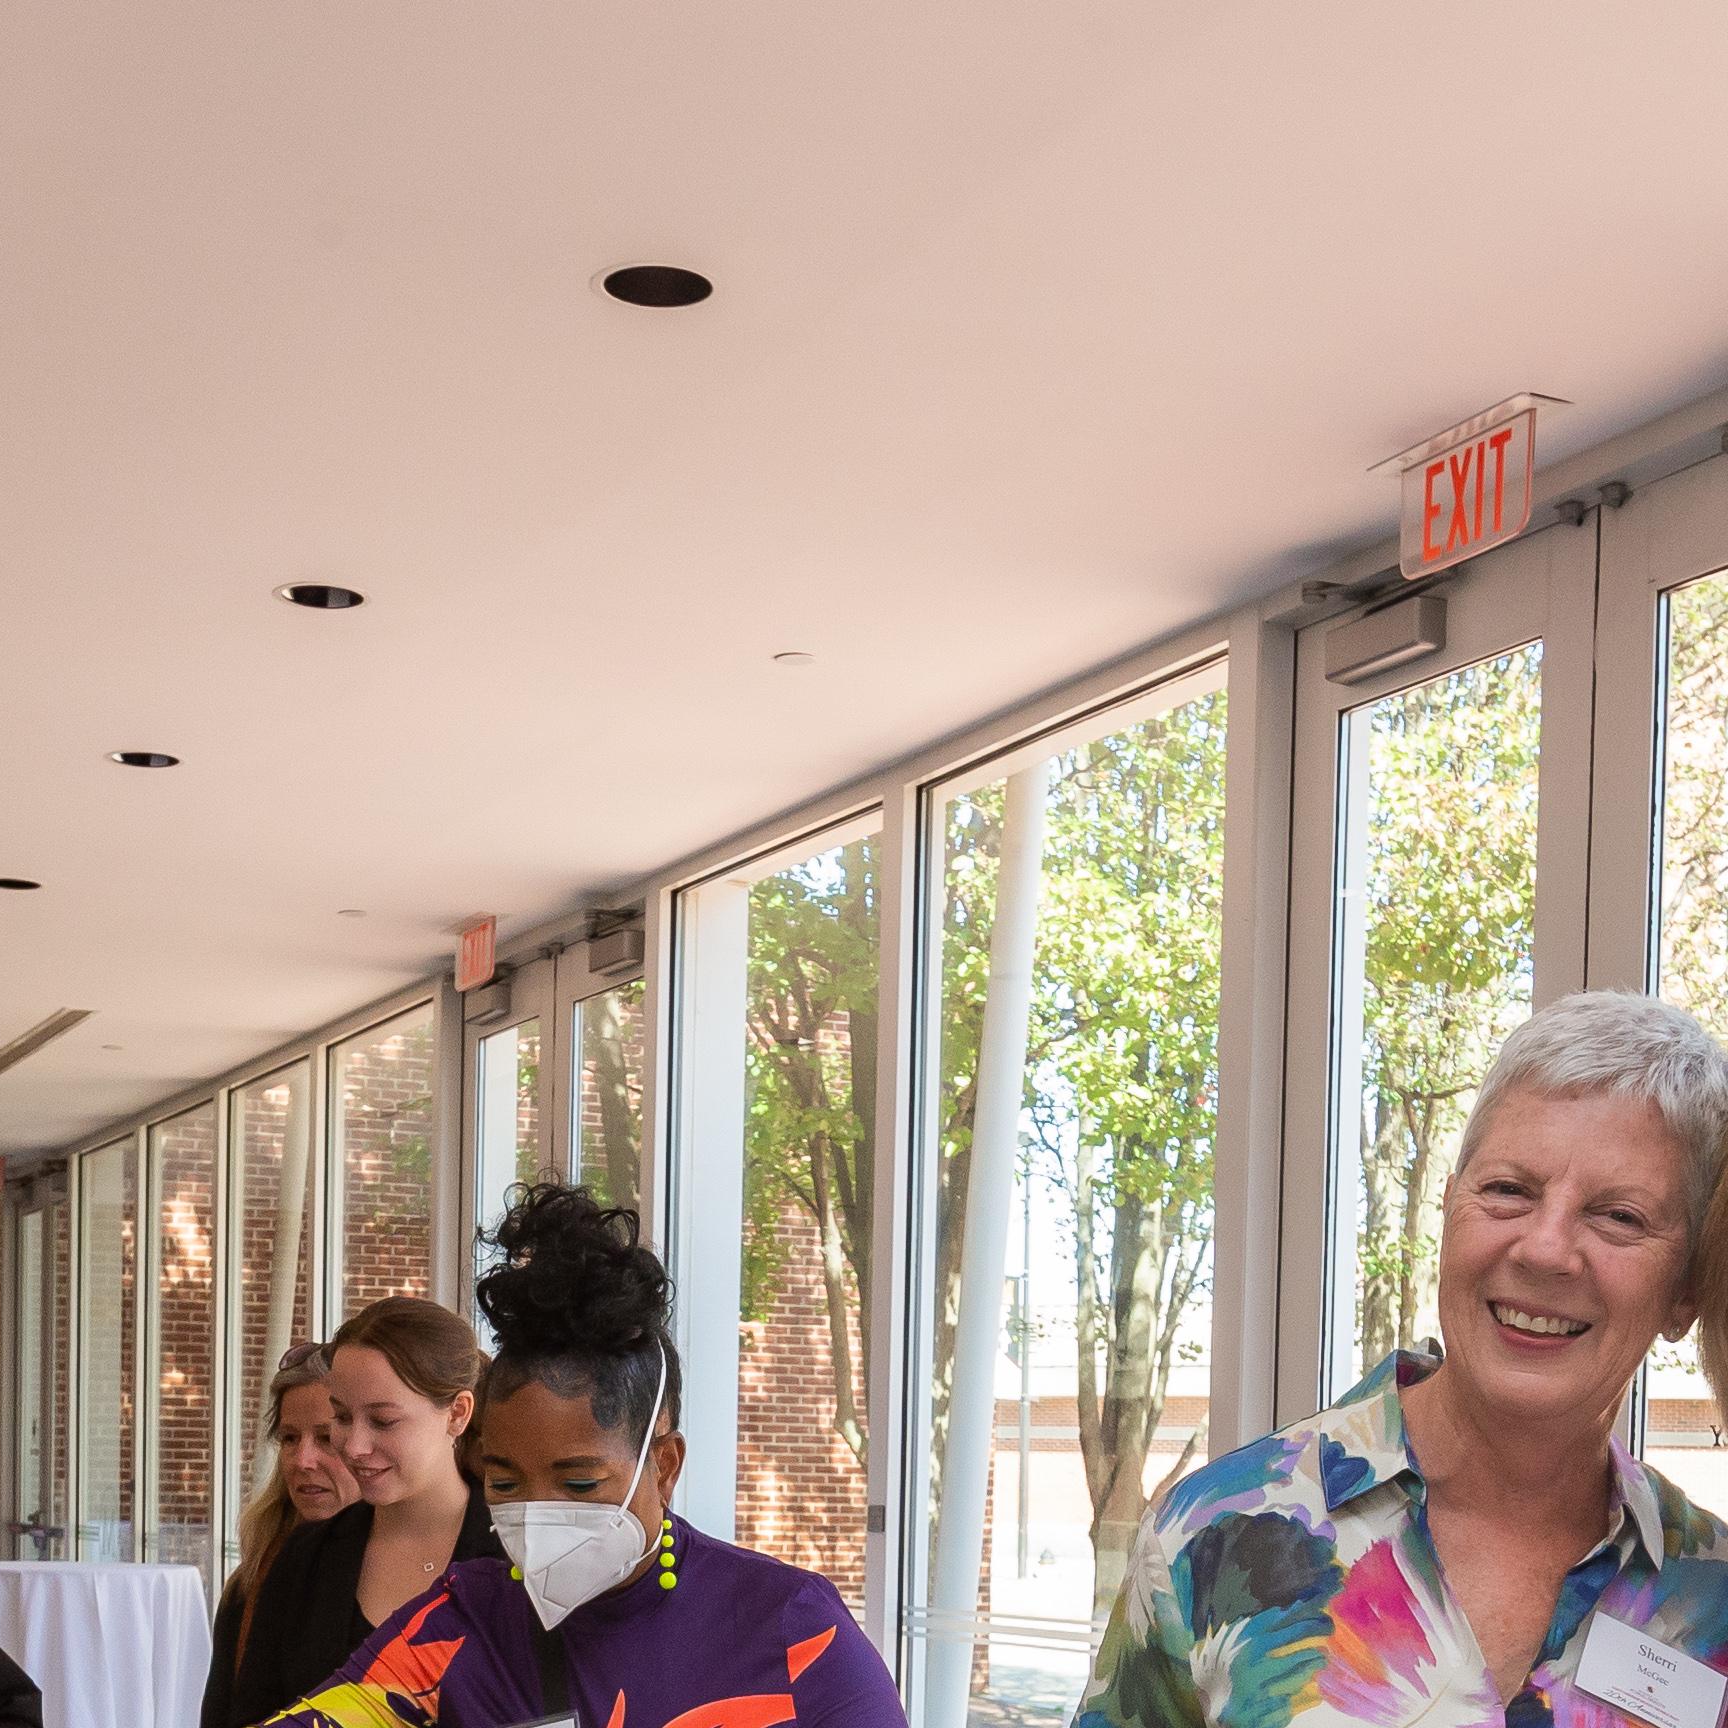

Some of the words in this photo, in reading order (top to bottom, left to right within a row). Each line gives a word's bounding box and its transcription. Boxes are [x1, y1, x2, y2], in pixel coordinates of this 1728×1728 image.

[1423, 427, 1512, 562] EXIT
[1638, 1643, 1678, 1672] Sherri
[1637, 1664, 1670, 1687] McGee
